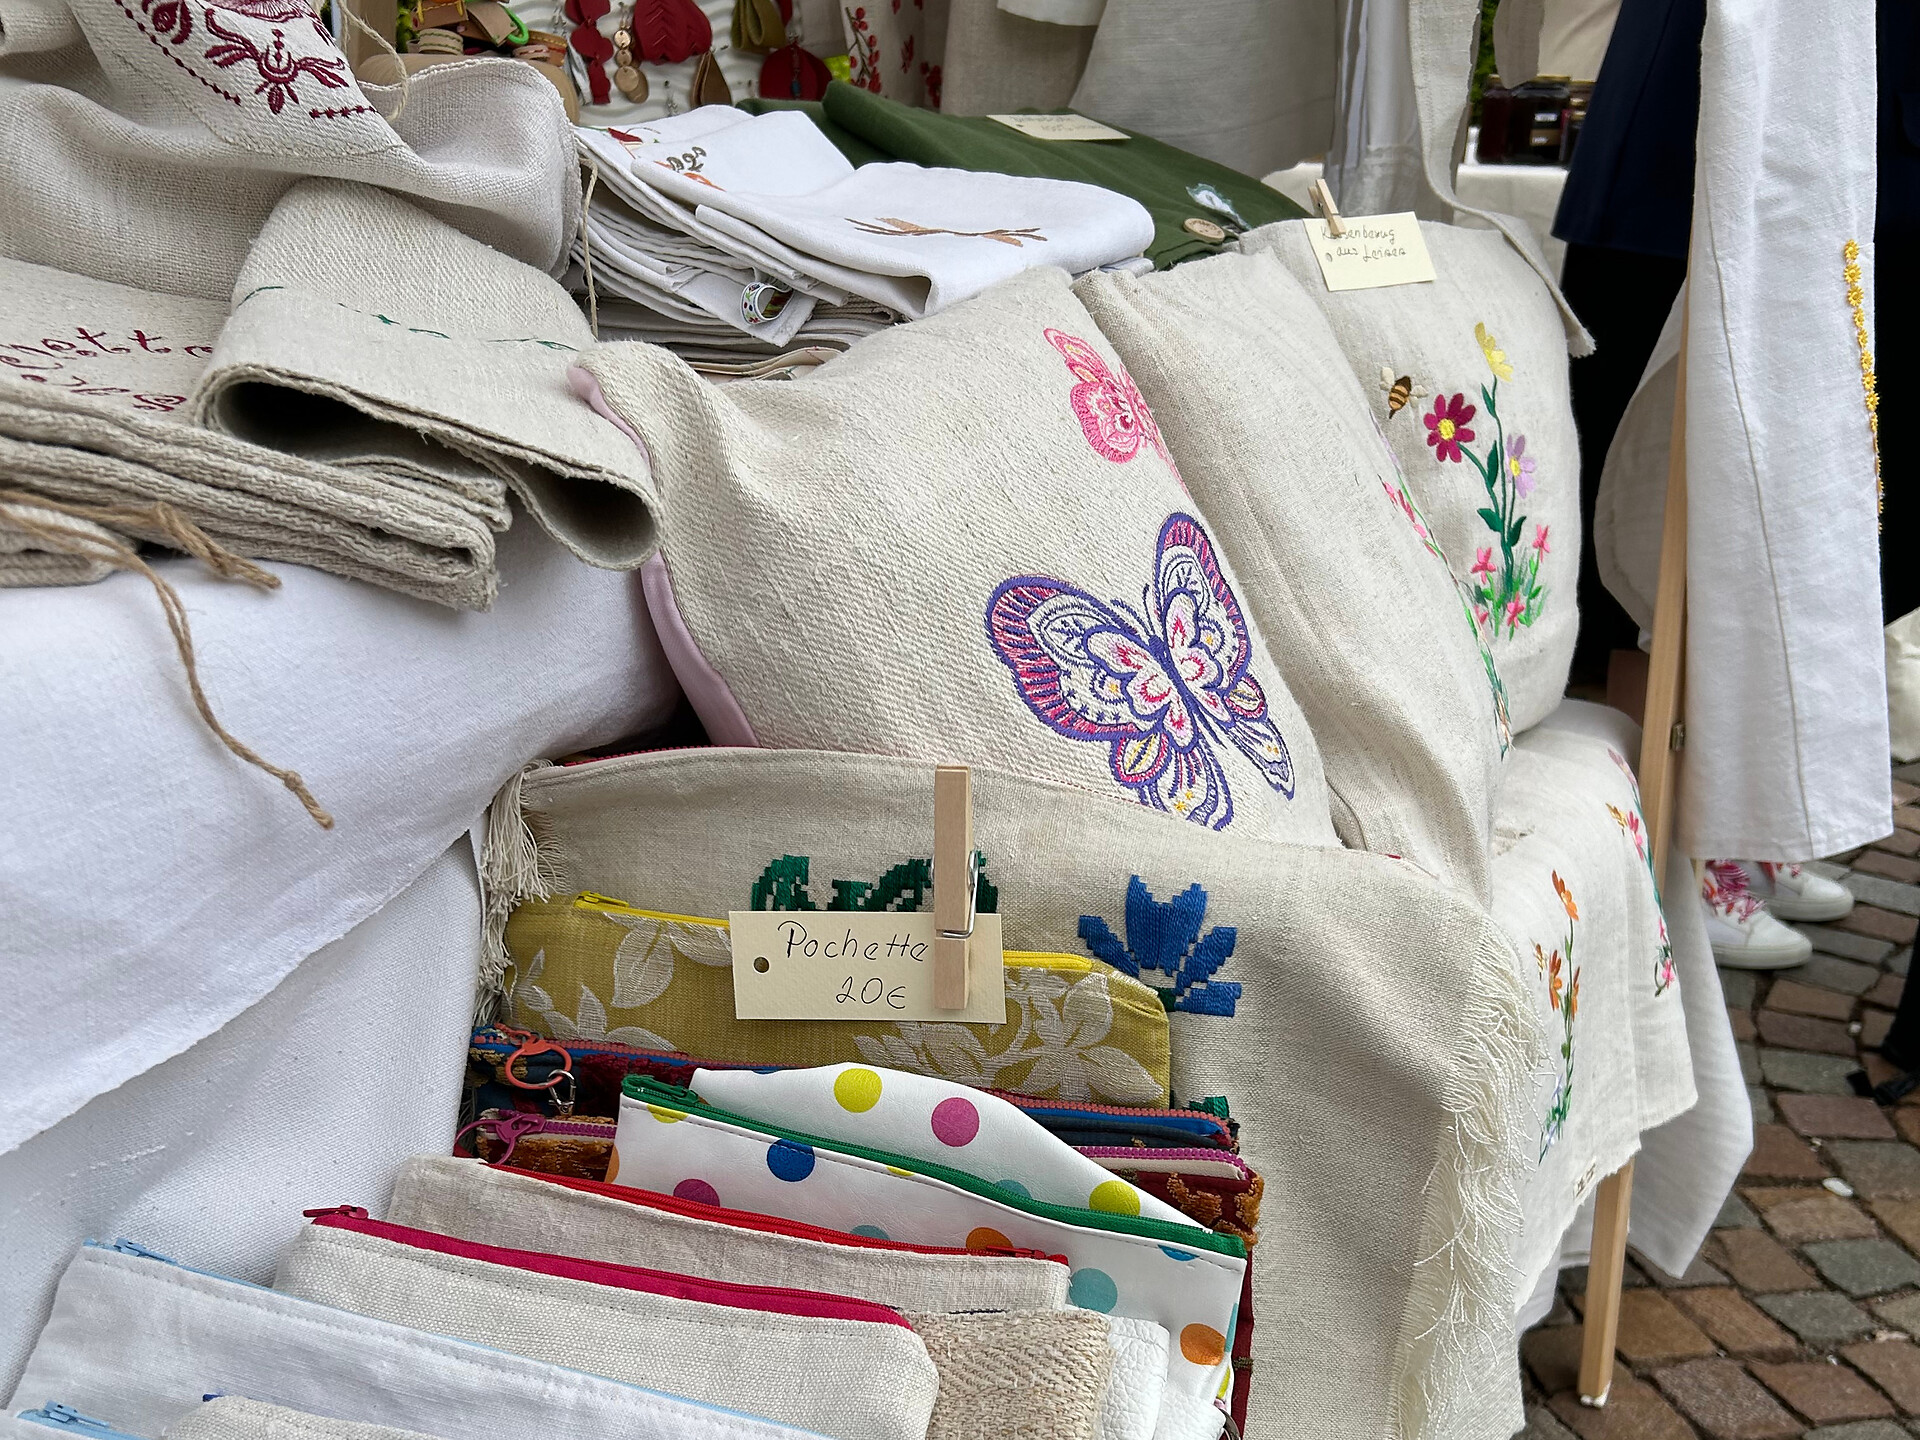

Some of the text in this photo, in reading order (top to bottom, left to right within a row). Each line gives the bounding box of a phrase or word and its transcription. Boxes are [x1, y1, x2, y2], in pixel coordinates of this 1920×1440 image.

[1320, 225, 1395, 245] Ksenbezug
[1336, 246, 1359, 257] aus
[777, 920, 929, 962] Pochette
[835, 975, 907, 1010] 20€
